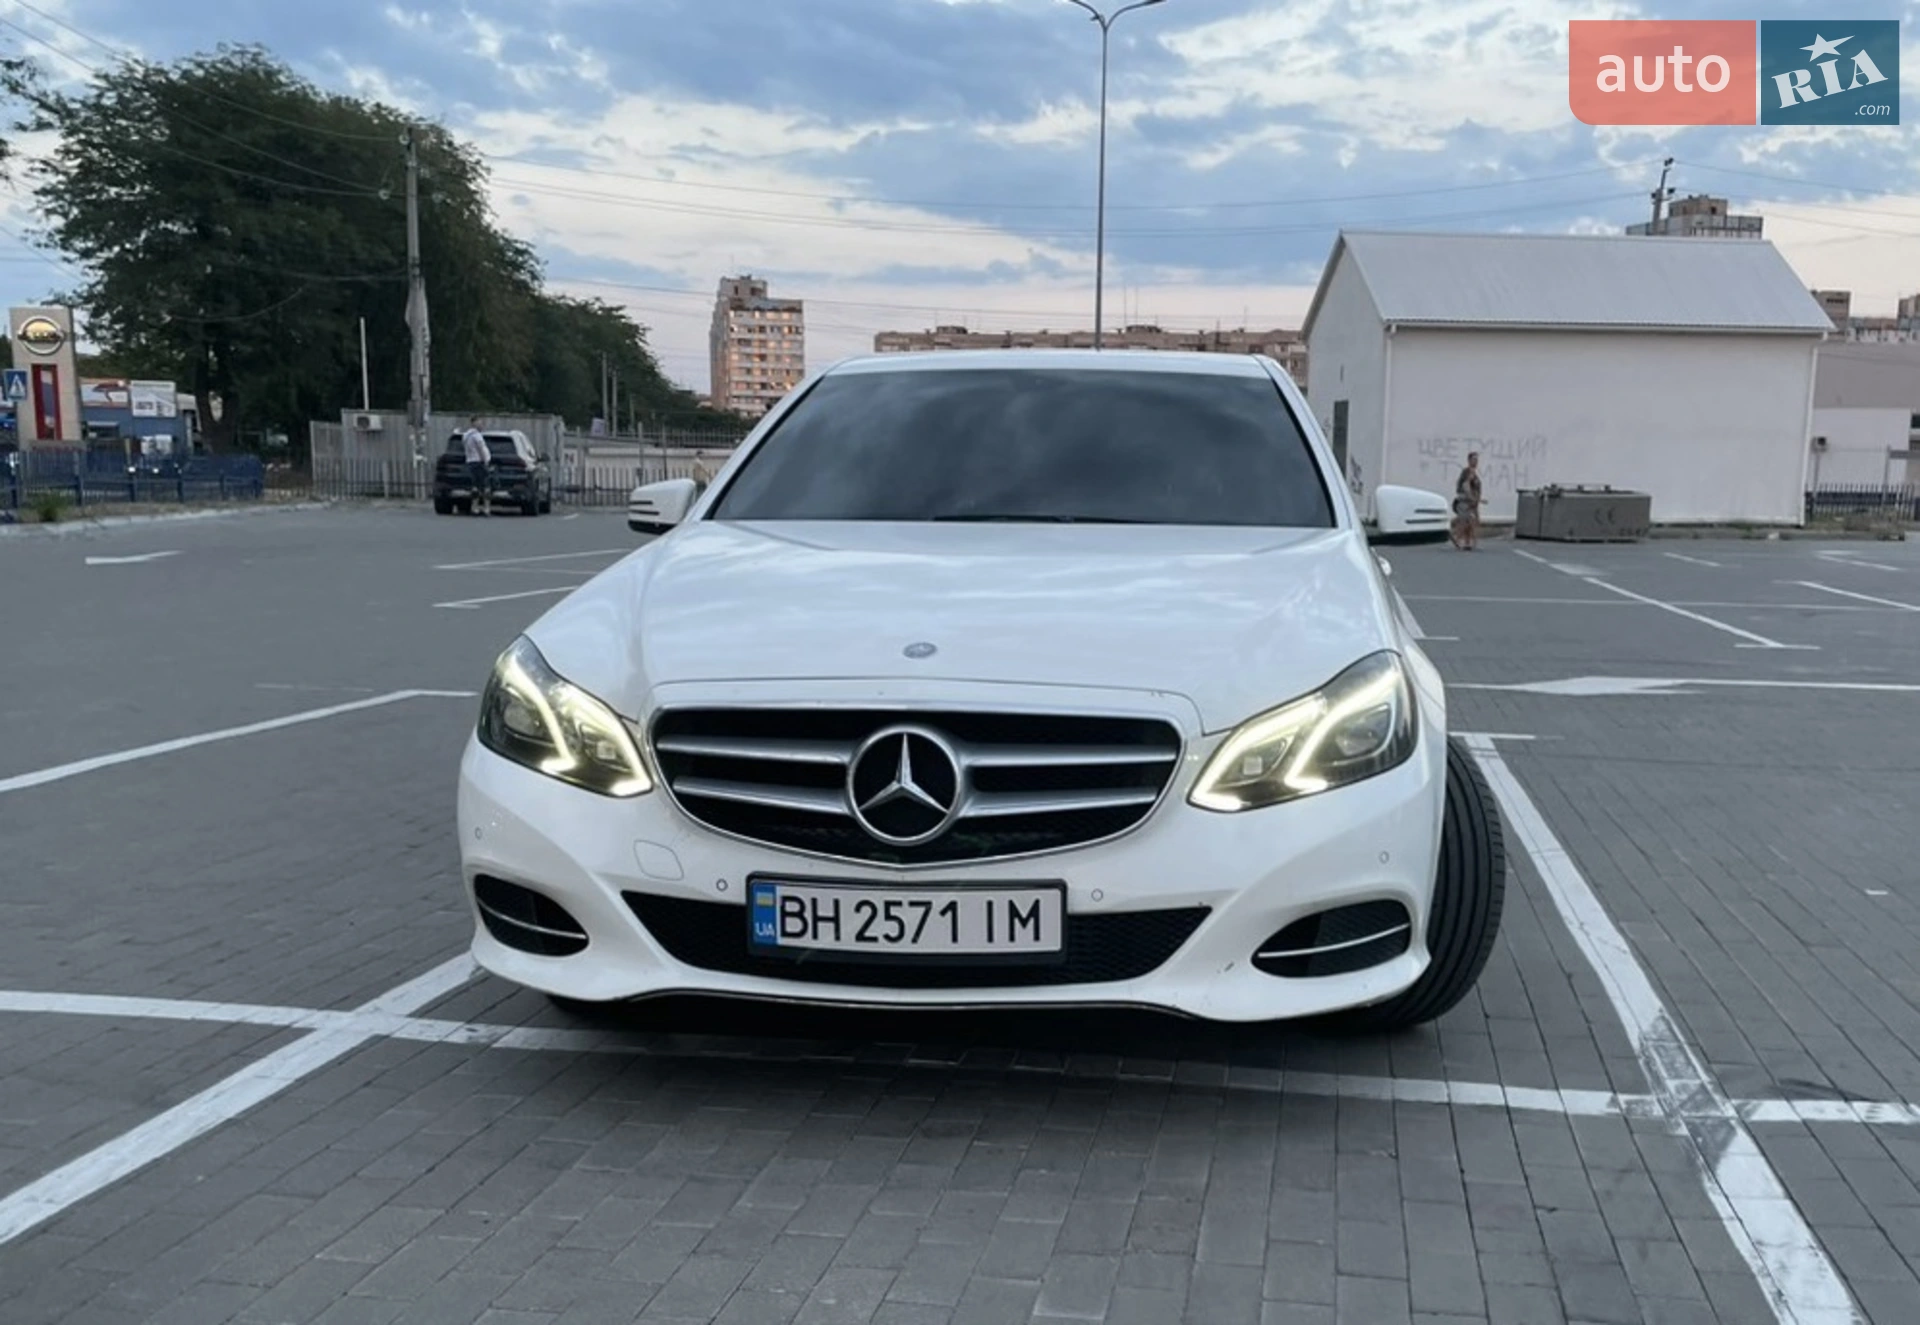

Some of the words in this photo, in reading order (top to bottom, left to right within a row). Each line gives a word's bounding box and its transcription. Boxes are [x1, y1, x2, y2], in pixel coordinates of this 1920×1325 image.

[755, 922, 775, 936] UA
[780, 895, 841, 941] BH
[854, 899, 959, 943] 2571
[986, 898, 1041, 943] IM
